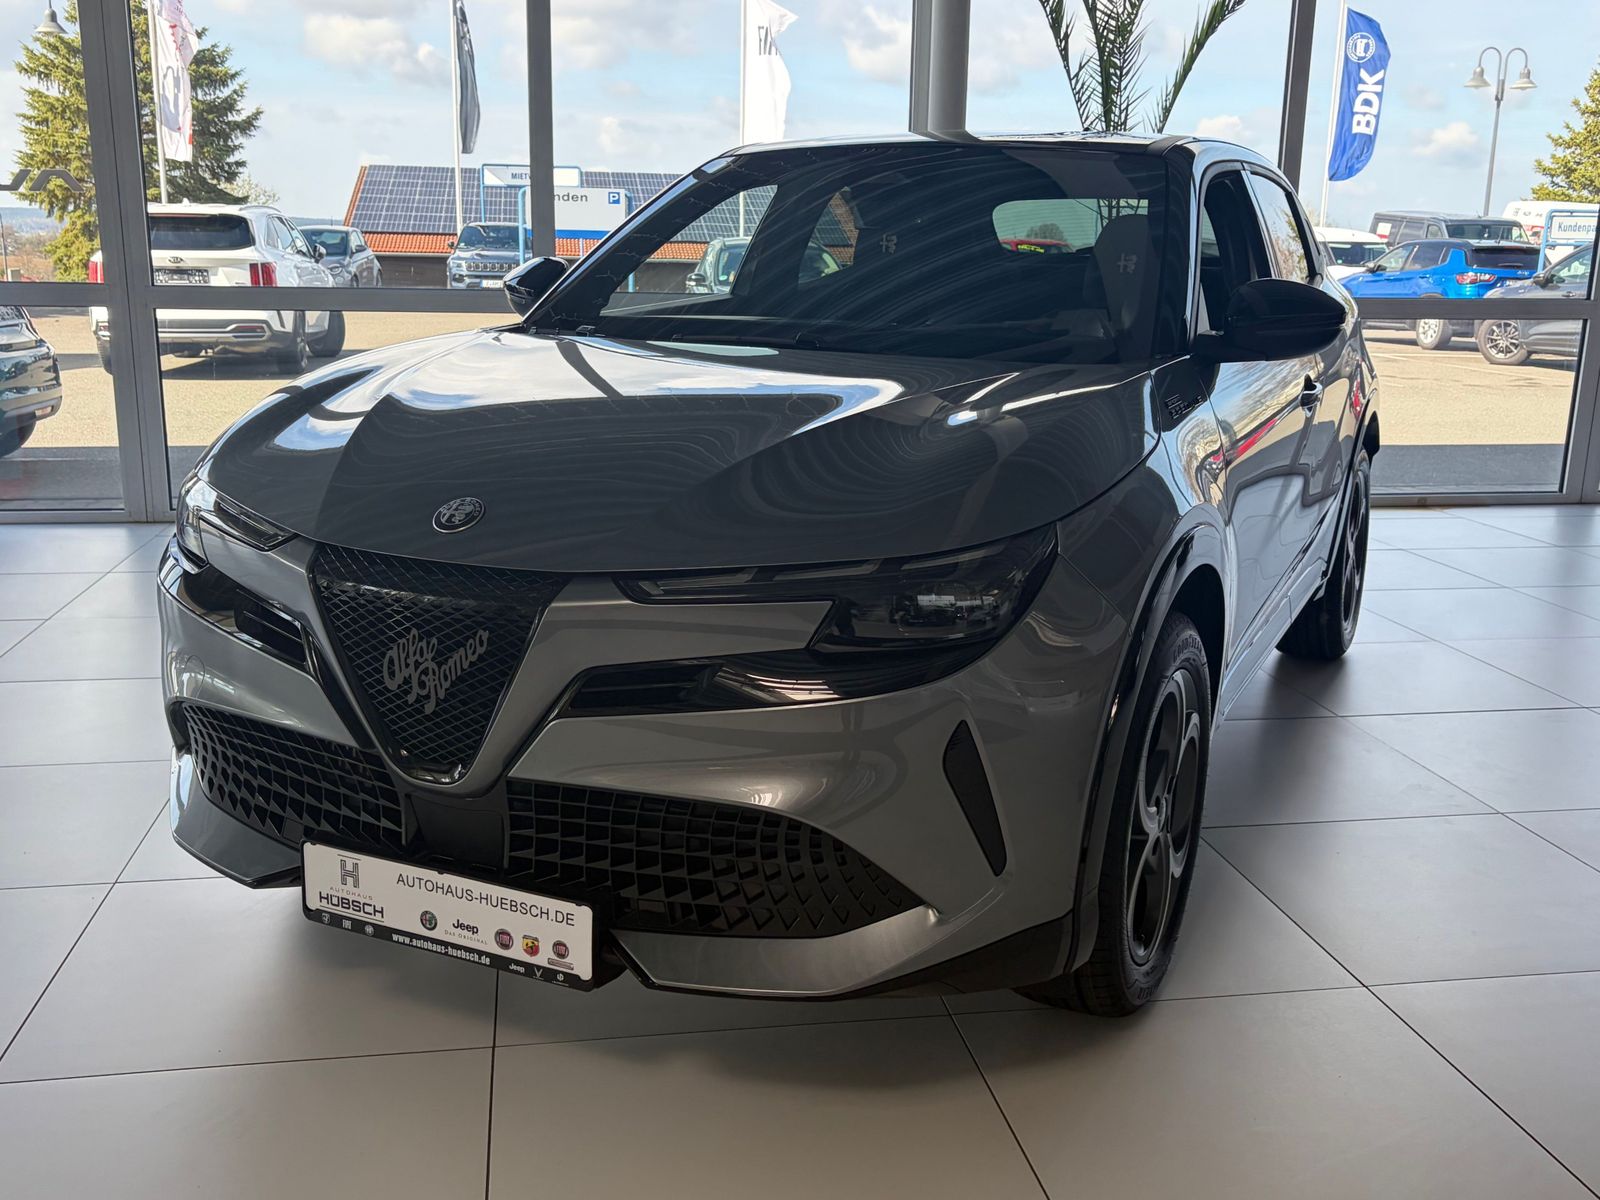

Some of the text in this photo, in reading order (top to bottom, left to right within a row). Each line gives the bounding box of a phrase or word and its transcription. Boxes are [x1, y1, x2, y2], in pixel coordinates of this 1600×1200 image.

[1352, 67, 1385, 135] BDK
[383, 628, 437, 704] Alfa
[417, 629, 489, 714] Romeo
[319, 891, 384, 918] HÜBSCH
[330, 886, 373, 901] AUTOHAUS
[397, 873, 576, 926] AUTOHAUS-HUEBSCH.DE
[391, 932, 491, 965] www.autohaus-huebsch.de
[452, 919, 479, 935] Jeep
